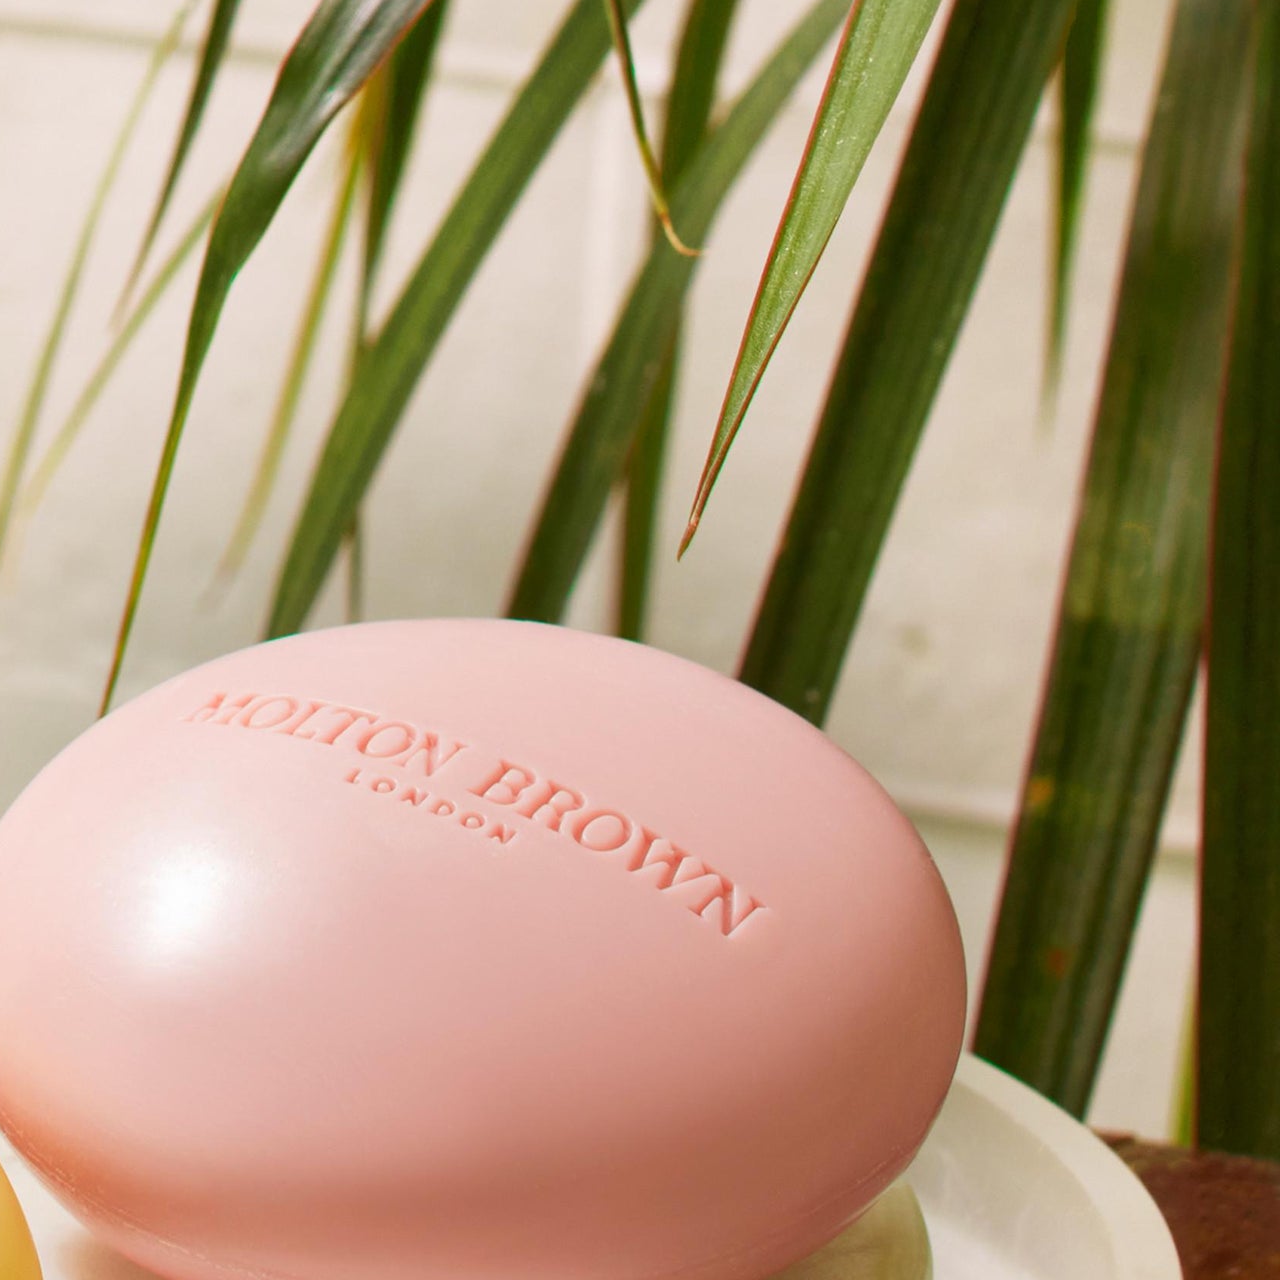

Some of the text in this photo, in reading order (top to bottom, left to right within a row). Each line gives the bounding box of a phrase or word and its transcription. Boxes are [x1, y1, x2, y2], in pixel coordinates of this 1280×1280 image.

[186, 691, 769, 937] MOLTON BROWN
[344, 768, 517, 845] LONDON
